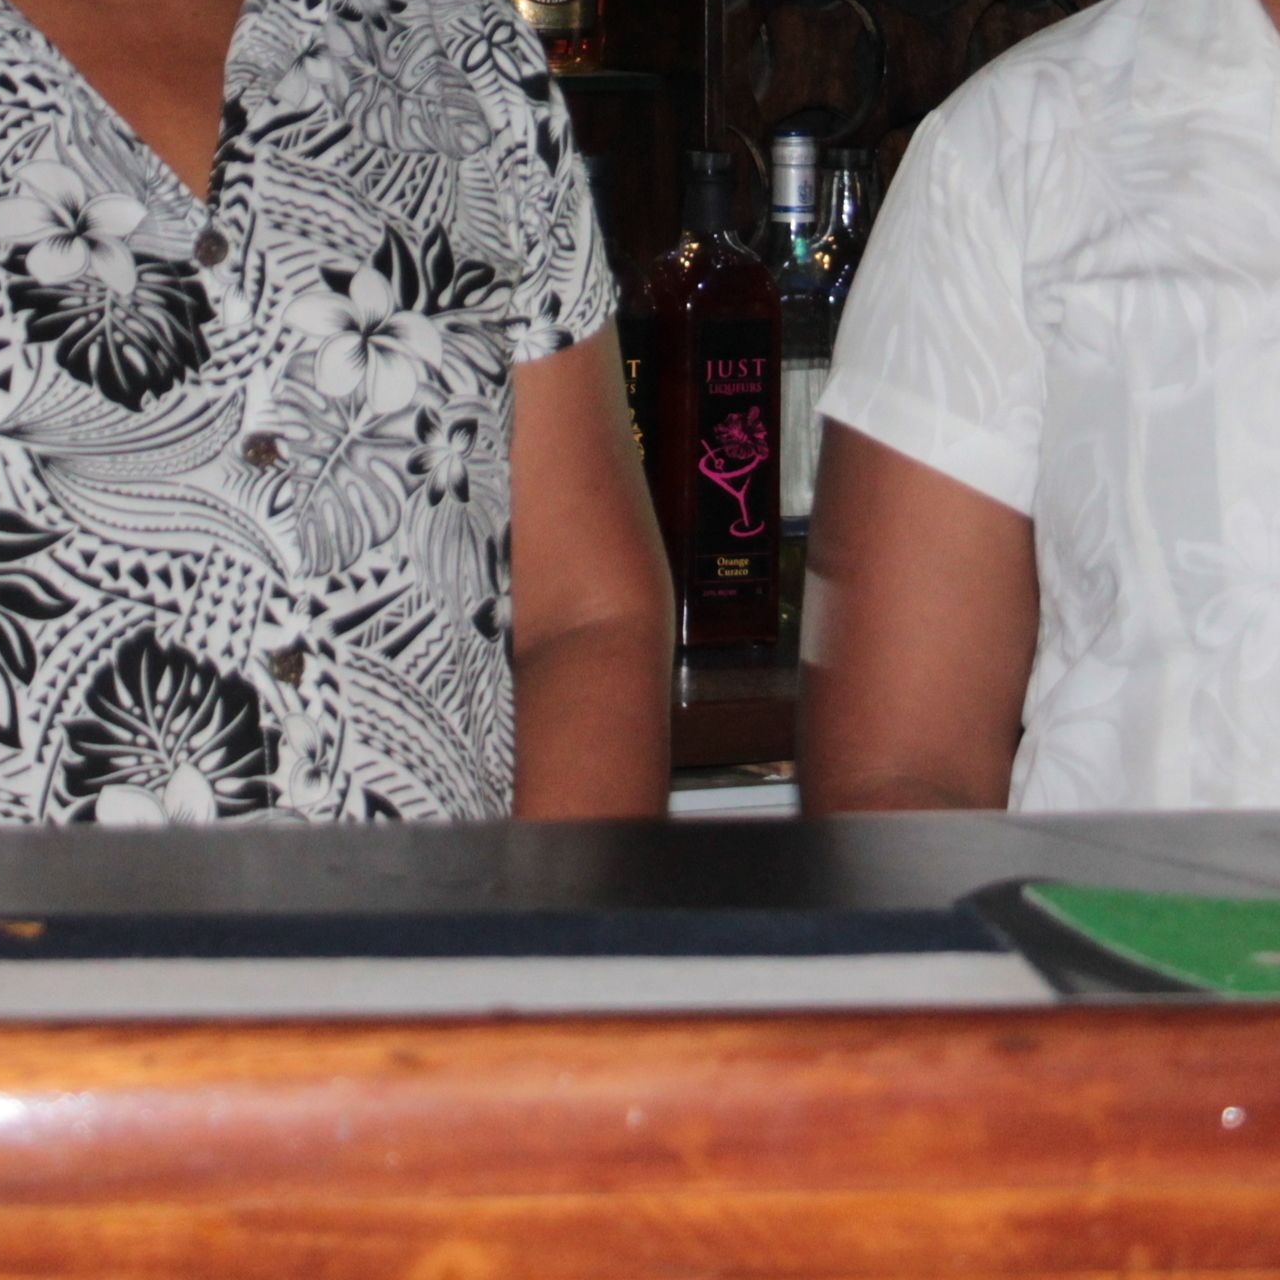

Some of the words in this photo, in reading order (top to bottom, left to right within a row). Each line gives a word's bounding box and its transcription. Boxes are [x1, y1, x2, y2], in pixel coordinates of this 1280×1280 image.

[706, 358, 767, 382] JUST
[709, 382, 763, 396] LIQUEURS
[717, 557, 750, 568] Orange
[717, 566, 749, 577] Curaco
